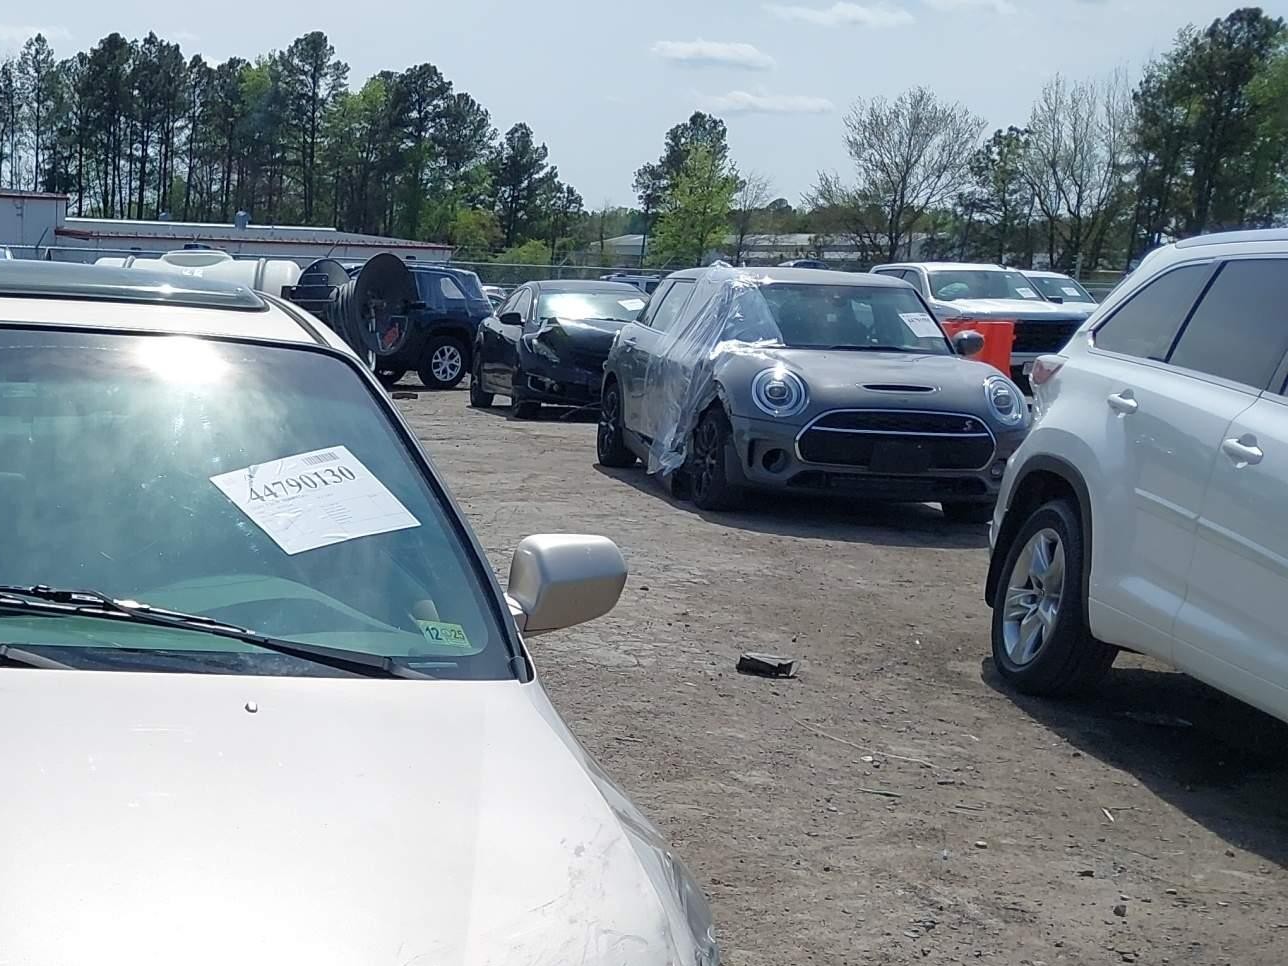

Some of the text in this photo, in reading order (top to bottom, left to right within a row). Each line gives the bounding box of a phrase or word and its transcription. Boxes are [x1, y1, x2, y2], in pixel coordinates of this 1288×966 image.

[248, 465, 357, 502] 44790130
[425, 626, 465, 641] 12 25
